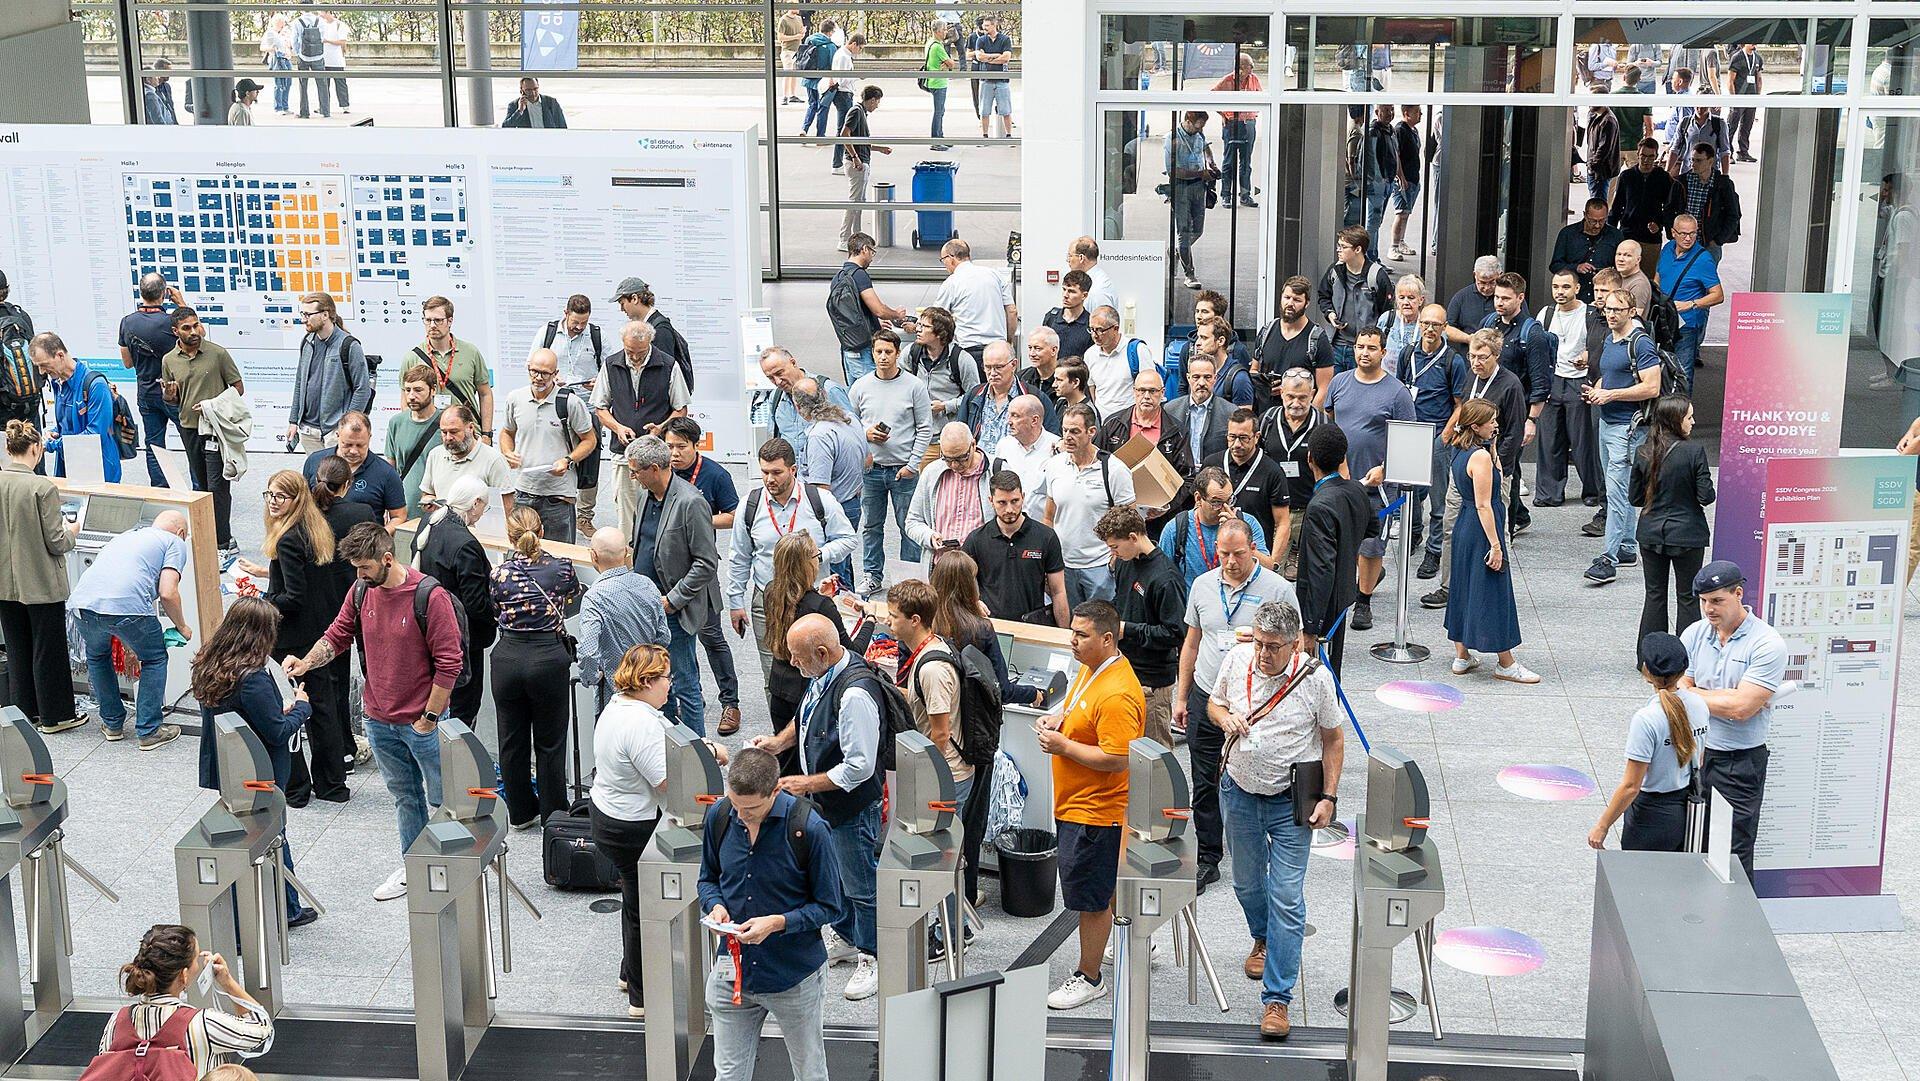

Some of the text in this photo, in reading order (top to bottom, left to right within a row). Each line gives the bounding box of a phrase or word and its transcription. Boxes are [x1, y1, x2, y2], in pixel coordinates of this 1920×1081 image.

[1100, 254, 1163, 262] Handdesinfektion
[1731, 410, 1831, 422] THANK YOU &
[1743, 424, 1817, 437] GOODBYE
[1739, 446, 1818, 457] See you next year
[1755, 456, 1765, 464] in
[1879, 481, 1903, 489] SSDV
[1877, 497, 1902, 505] SGDV
